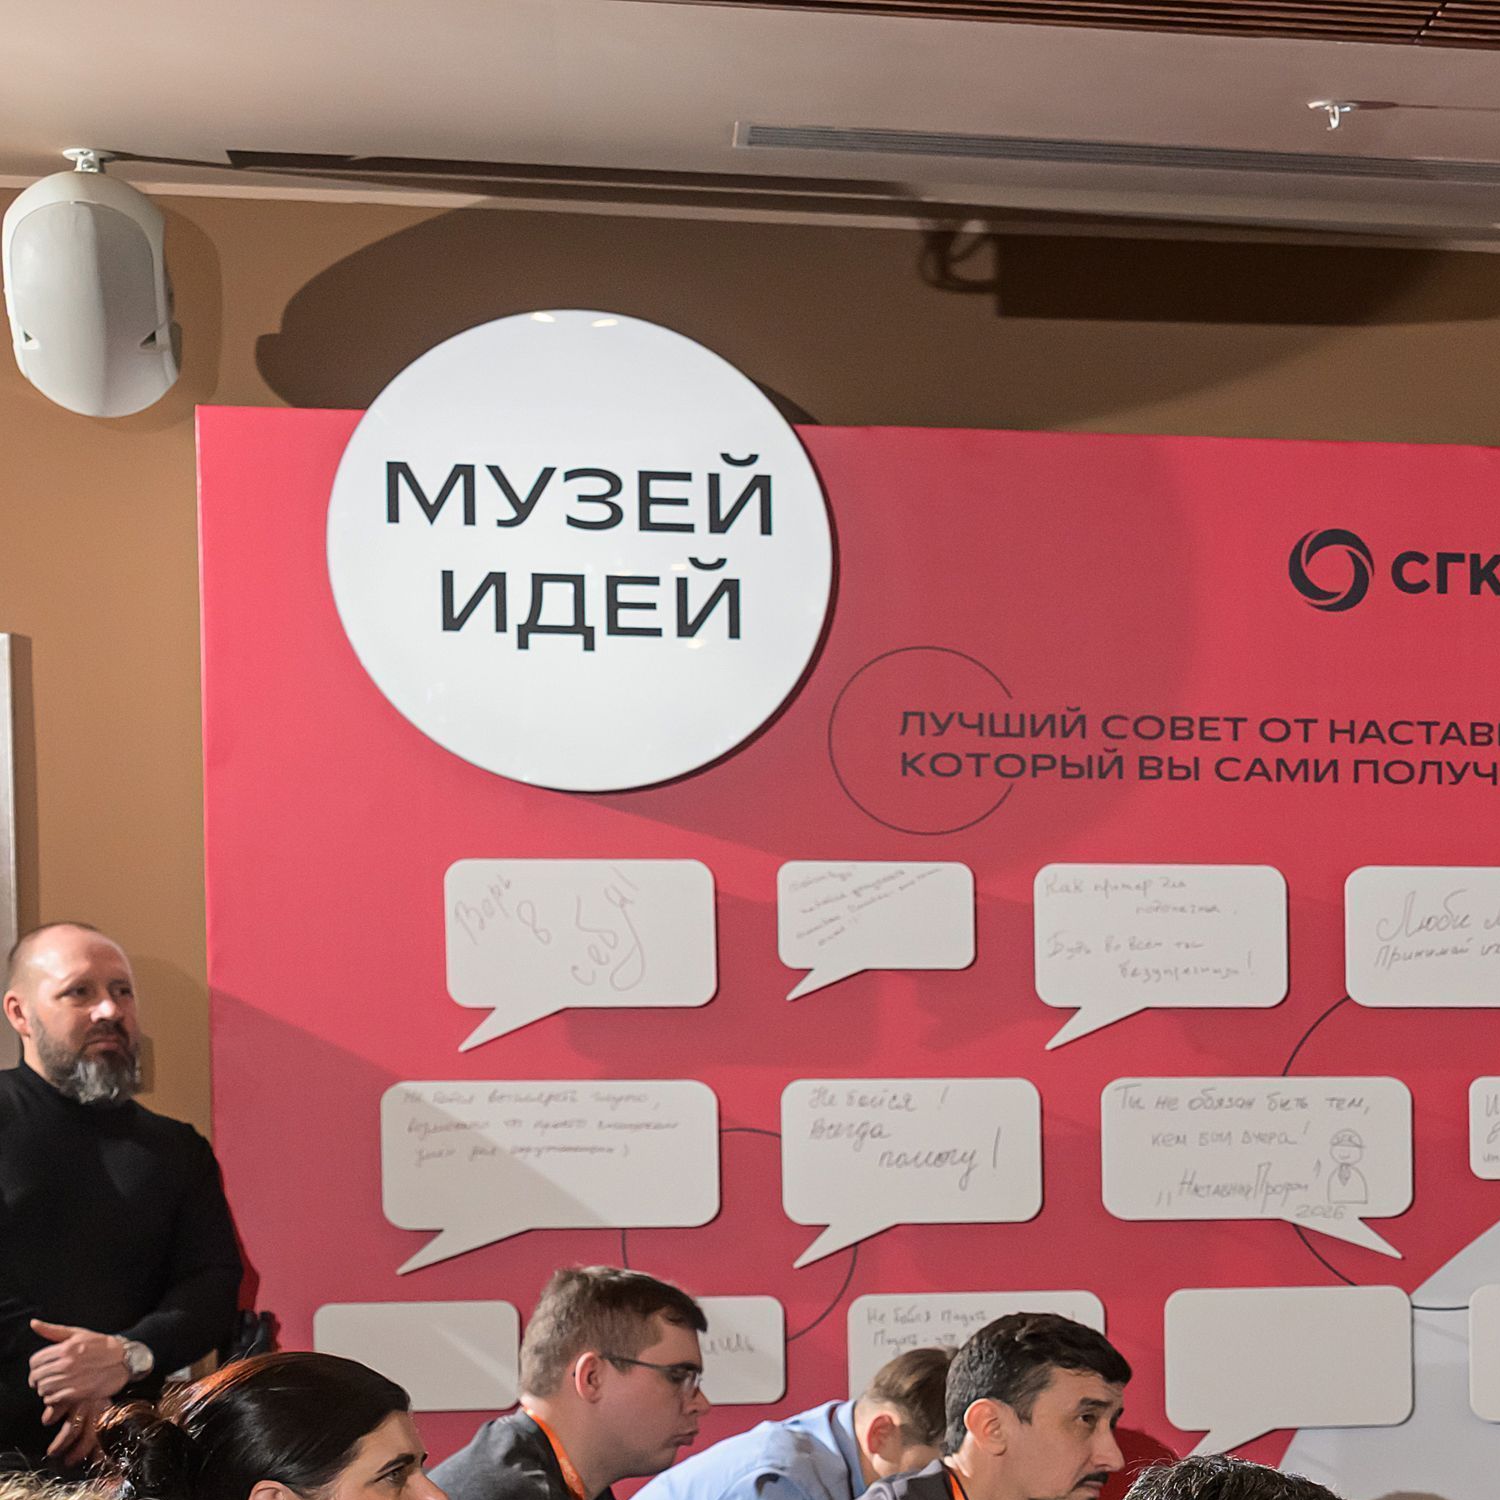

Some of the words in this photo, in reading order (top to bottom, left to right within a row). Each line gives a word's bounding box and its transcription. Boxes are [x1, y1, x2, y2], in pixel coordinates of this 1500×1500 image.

[385, 452, 774, 536] МУЗЕЙ
[440, 556, 742, 652] ИДЕЙ
[899, 705, 1088, 740] ЛУЧШИЙ
[1101, 712, 1248, 743] СОВЕТ
[1258, 717, 1321, 745] ОТ
[899, 746, 1126, 781] КОТОРЫЙ
[1138, 755, 1200, 783] ВЫ
[1214, 757, 1340, 785] САМИ
